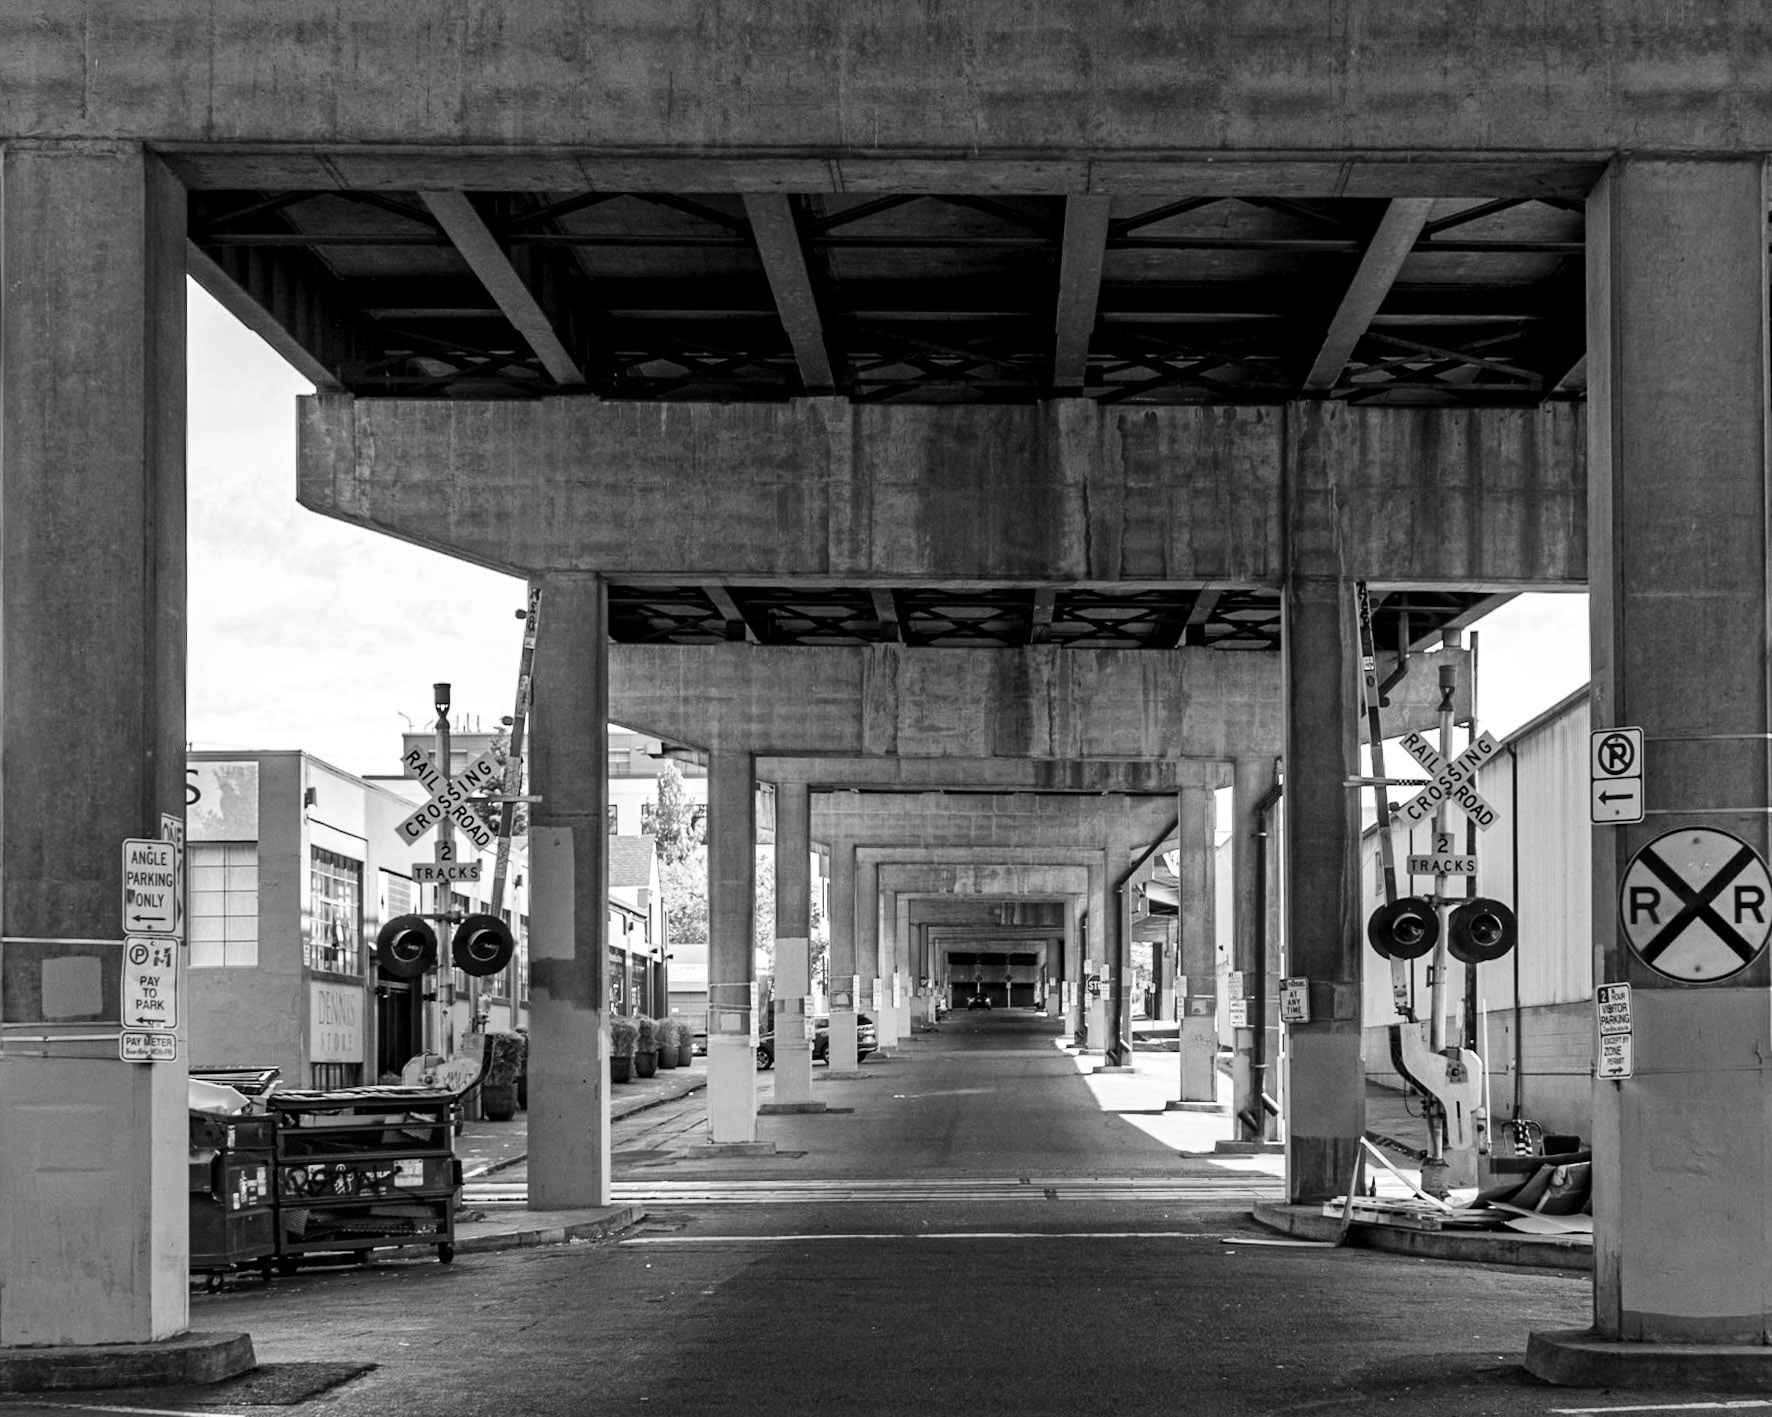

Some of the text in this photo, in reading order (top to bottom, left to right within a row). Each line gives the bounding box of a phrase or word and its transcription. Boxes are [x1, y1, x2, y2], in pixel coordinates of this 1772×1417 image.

[1404, 733, 1493, 825] RAIL ROAD
[1407, 740, 1492, 819] CROSSING
[405, 750, 490, 846] RAIL ROAD
[405, 761, 491, 837] CROSSING
[1437, 838, 1448, 853] 2
[131, 851, 167, 866] ANGLE
[441, 846, 451, 860] 2
[1411, 860, 1475, 871] TRACKS
[127, 871, 173, 888] PARKING
[415, 867, 478, 879] TRACKS
[136, 893, 164, 908] ONLY
[1630, 885, 1765, 924] R R
[140, 976, 160, 987] PAY
[142, 988, 157, 998] TO
[1601, 990, 1606, 1002] 2
[136, 999, 165, 1010] PARK
[1601, 1013, 1629, 1025] PARKING
[126, 1037, 172, 1047] PAY METER
